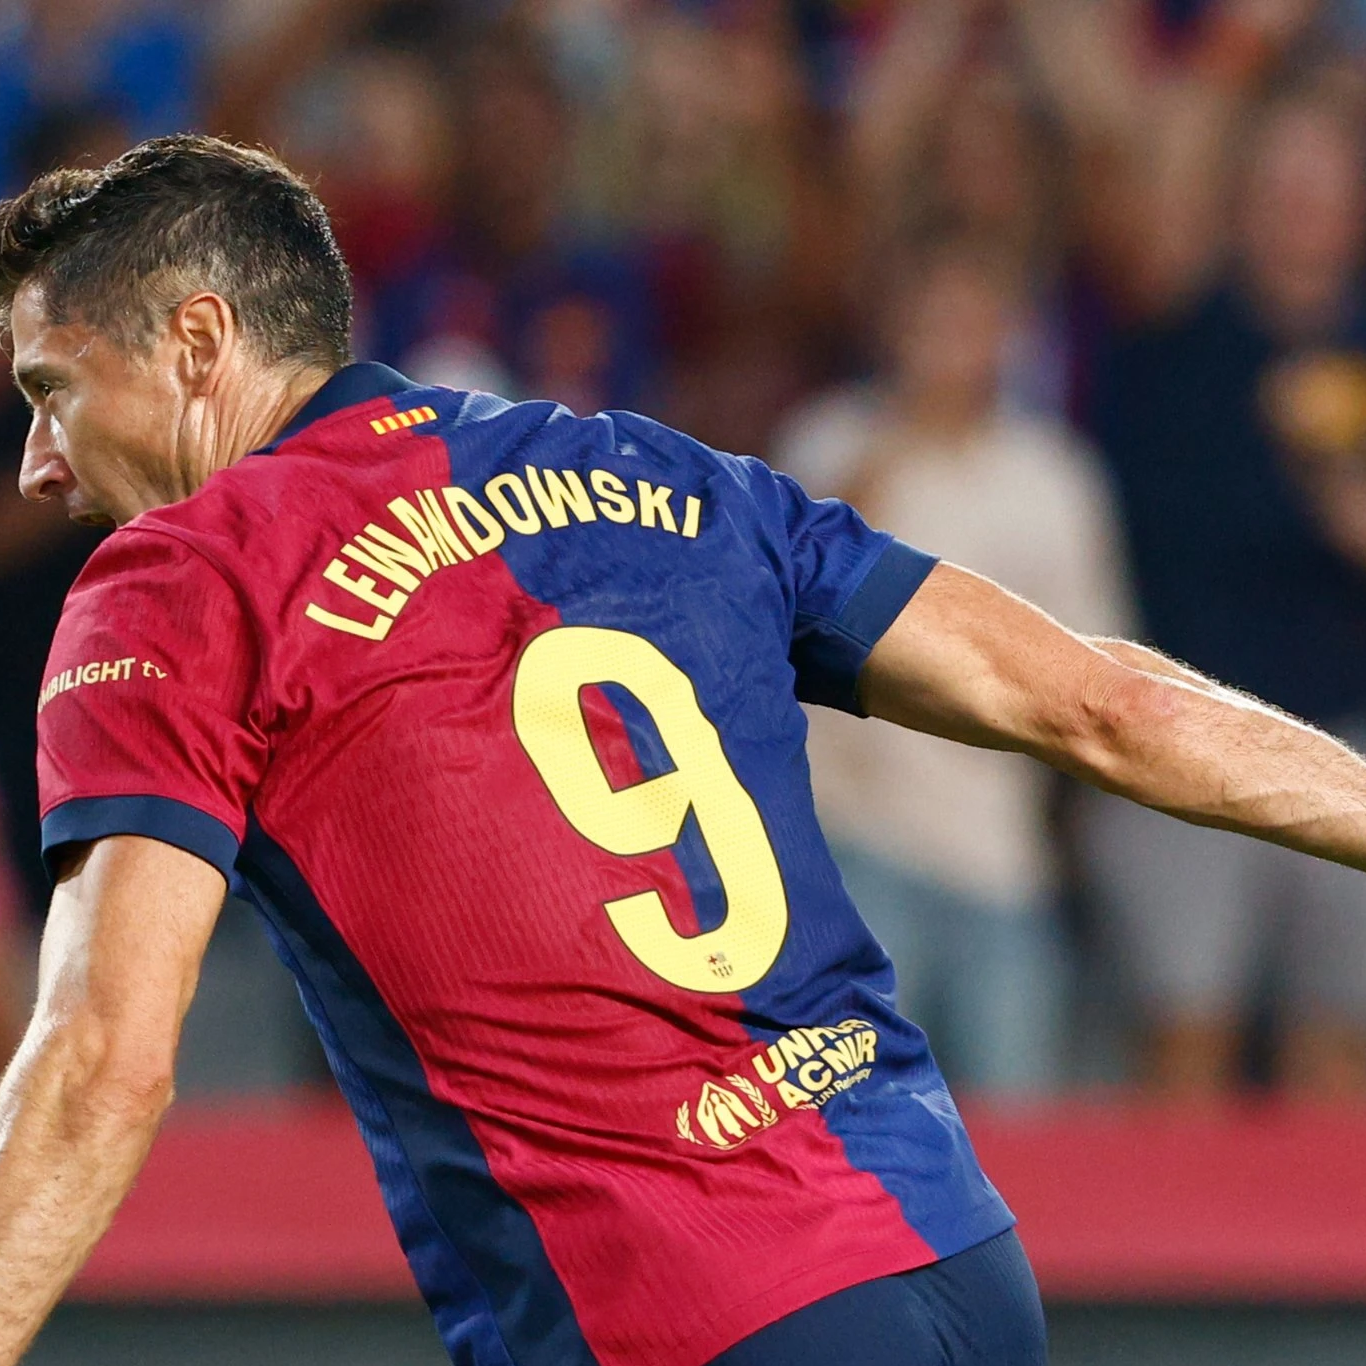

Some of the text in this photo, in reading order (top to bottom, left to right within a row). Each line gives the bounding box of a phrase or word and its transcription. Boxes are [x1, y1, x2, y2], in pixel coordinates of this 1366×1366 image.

[304, 464, 701, 642] LEWANDOWSKI
[141, 660, 168, 679] tv
[511, 625, 790, 994] 9
[776, 1030, 878, 1109] ACNUR
